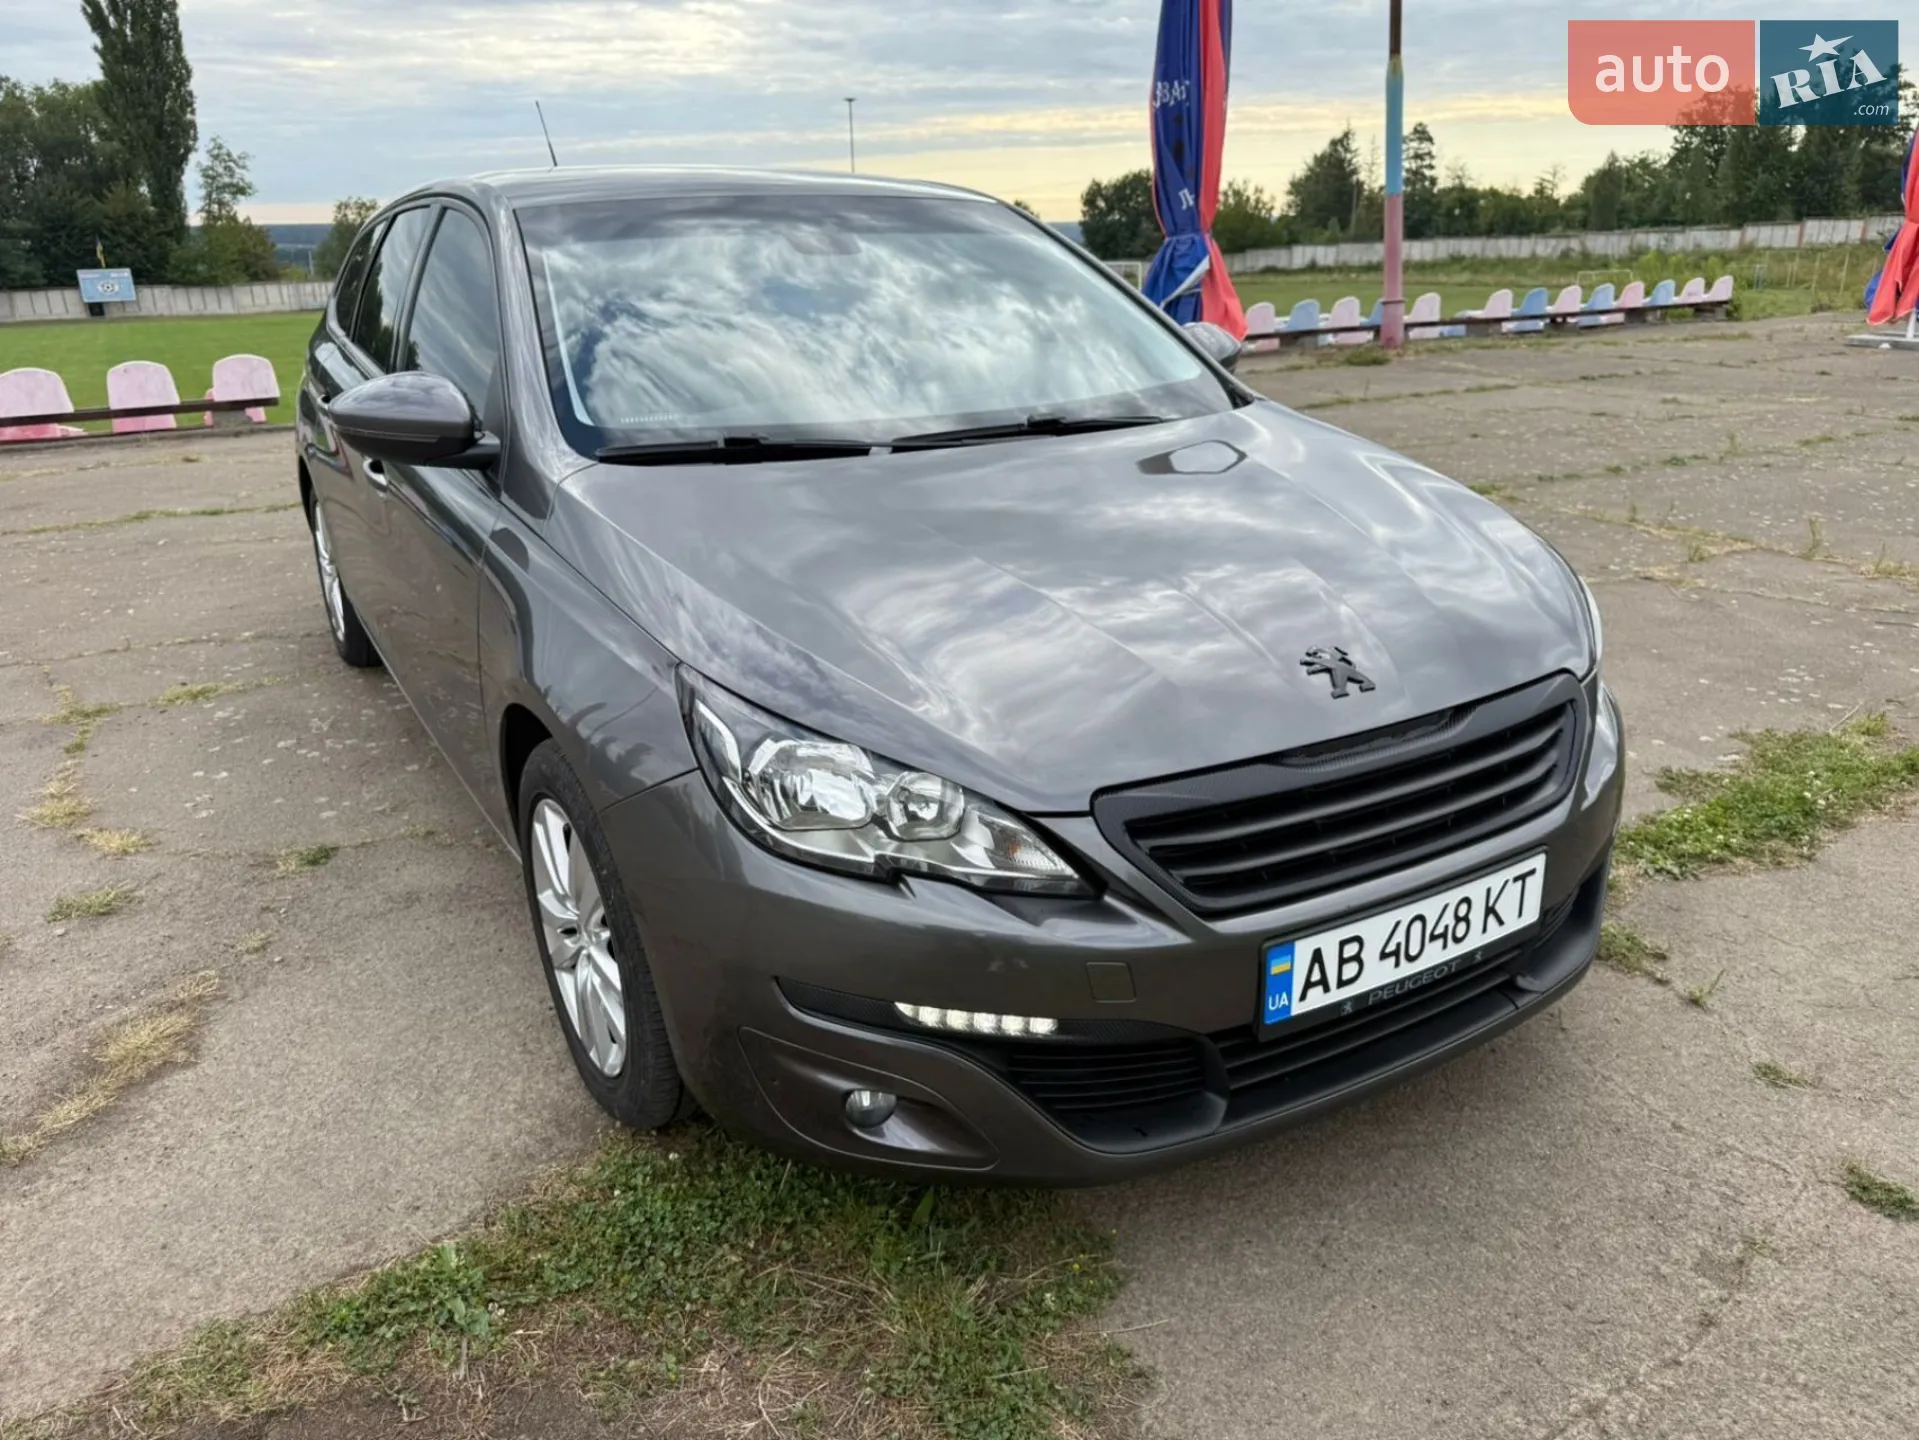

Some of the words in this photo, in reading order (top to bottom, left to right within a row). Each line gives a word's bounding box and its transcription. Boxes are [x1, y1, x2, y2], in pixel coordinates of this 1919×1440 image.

[1298, 934, 1365, 1003] AB
[1378, 895, 1473, 970] 4048
[1481, 867, 1537, 935] KT
[1268, 994, 1290, 1011] UA
[1367, 958, 1462, 1006] PEUGEOT
